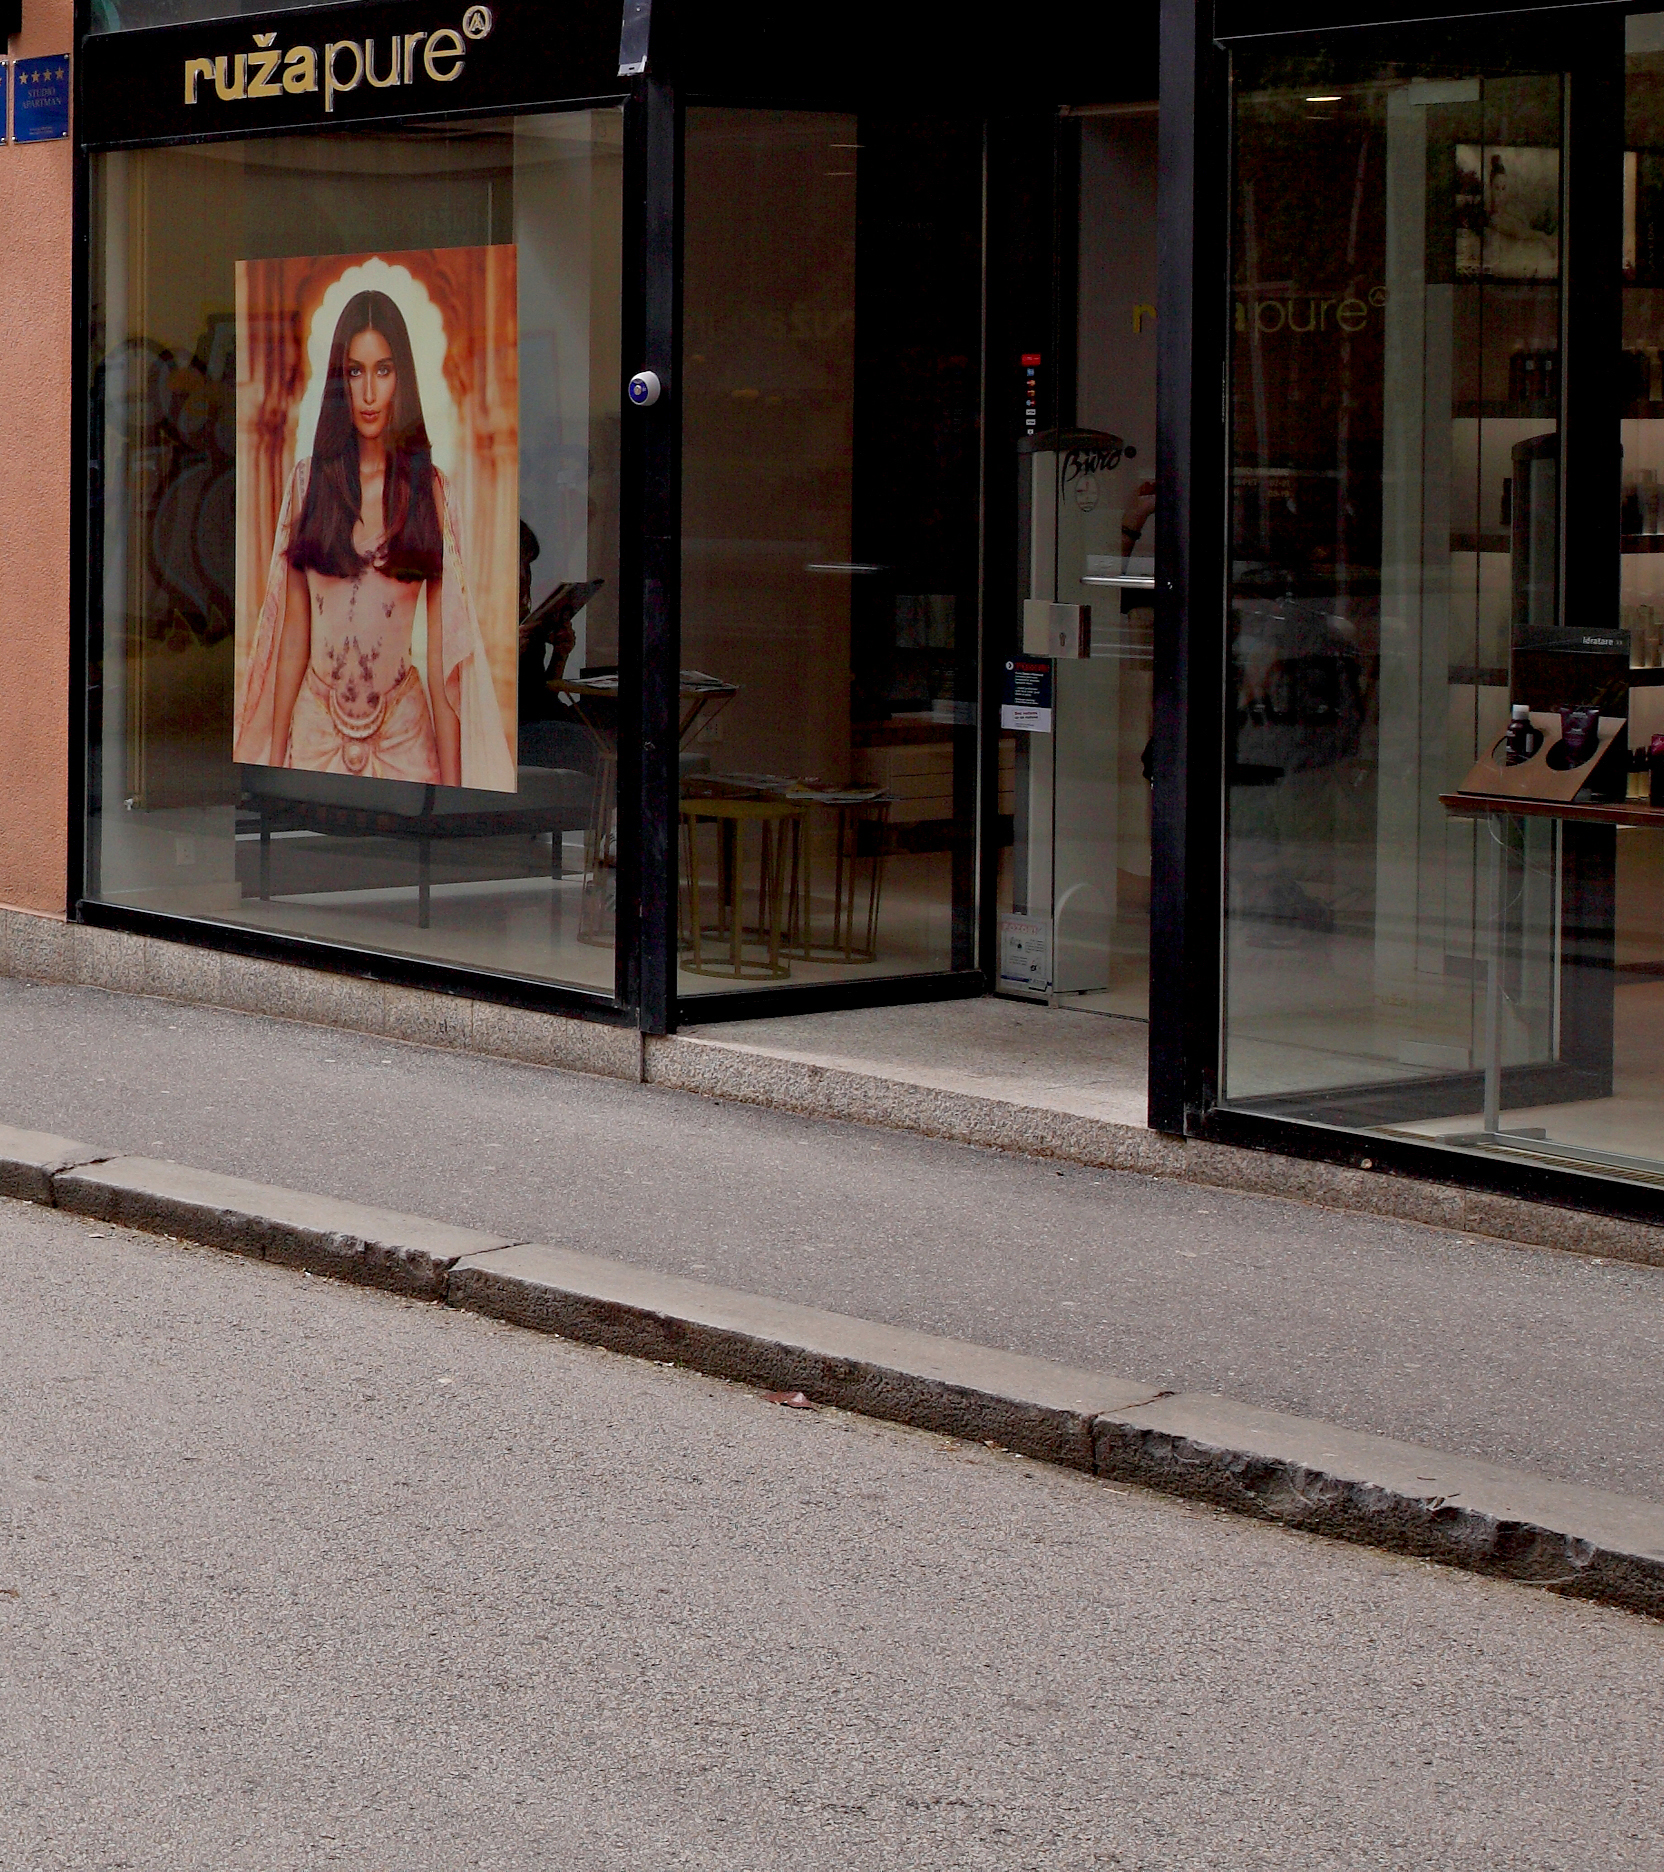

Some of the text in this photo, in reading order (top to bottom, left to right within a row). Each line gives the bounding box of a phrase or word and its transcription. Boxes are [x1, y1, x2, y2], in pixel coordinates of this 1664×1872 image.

[28, 87, 56, 98] STUDIO
[22, 97, 63, 110] APARTMAN
[1582, 636, 1614, 646] Idratare
